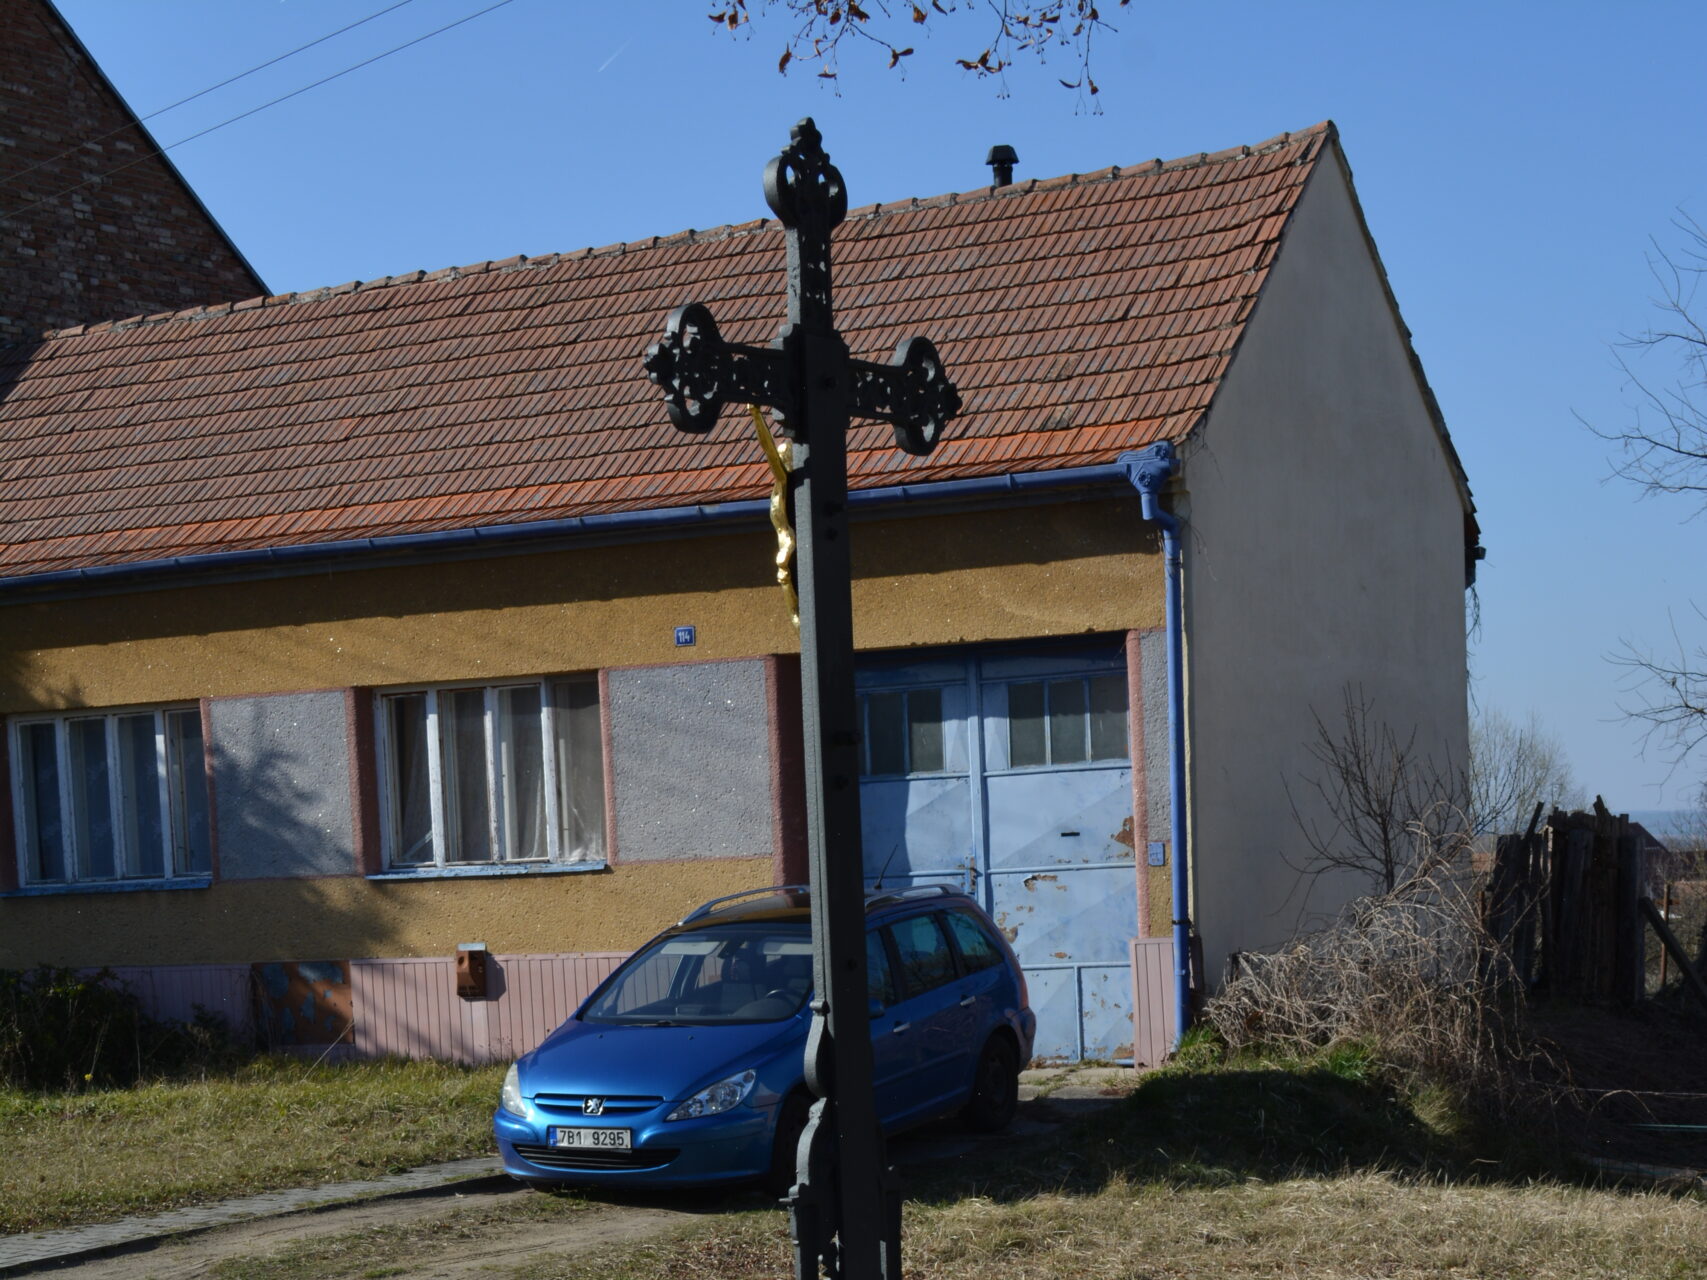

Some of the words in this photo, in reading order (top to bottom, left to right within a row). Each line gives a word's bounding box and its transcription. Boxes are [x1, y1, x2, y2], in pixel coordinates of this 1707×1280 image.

[678, 631, 690, 643] 114
[559, 1130, 582, 1145] 7B1
[592, 1131, 624, 1146] 9295
